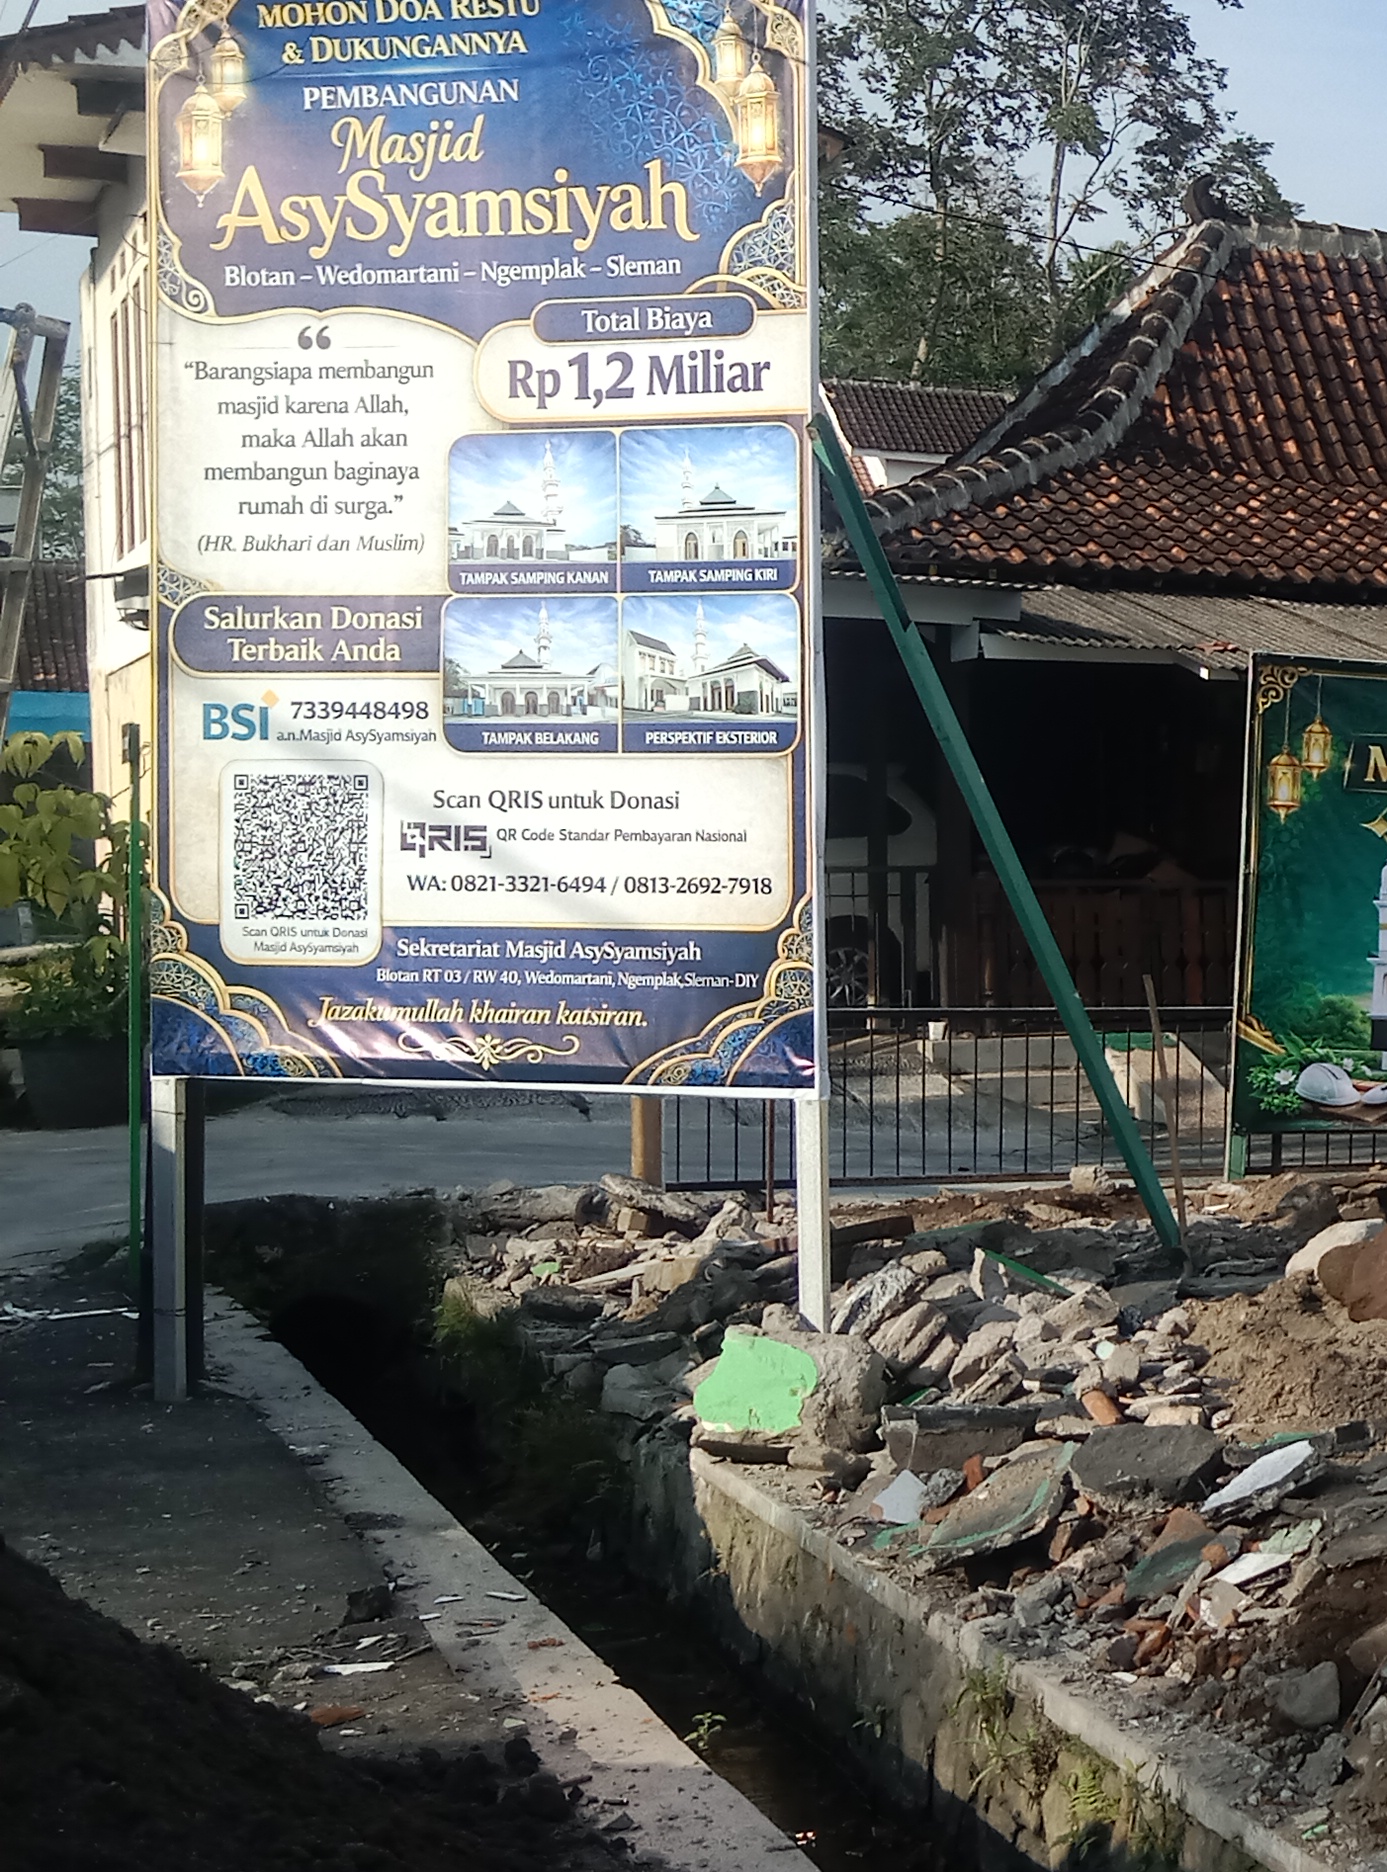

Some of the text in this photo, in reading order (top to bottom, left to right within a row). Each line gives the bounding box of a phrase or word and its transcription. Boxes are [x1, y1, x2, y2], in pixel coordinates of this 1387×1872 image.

[257, 0, 367, 28] MOHON
[376, 0, 444, 24] DOA
[281, 31, 528, 64] & DUKUNGANNYA
[303, 79, 519, 110] PEMBANGUNAN
[331, 114, 484, 181] Masjid
[210, 159, 700, 259] AsySyamsiyah
[224, 265, 296, 287] Blotan
[316, 261, 459, 285] Wedomartani
[481, 257, 585, 288] Ngemplak
[607, 255, 681, 277] Sleman
[581, 307, 713, 335] Total Biaya
[184, 359, 434, 386] “Barangsiapa membangun
[507, 349, 771, 409] Rp 1,2 Miliar
[217, 394, 409, 419] masjid karena Allah,
[241, 427, 408, 448] maka Allah akan
[203, 460, 420, 486] membangun baginaya
[238, 494, 403, 520] rumah di surga.”
[197, 533, 425, 555] (HR. Bukhari dan Muslim)
[459, 571, 609, 586] TAMPAK SAMPING KANAN
[648, 568, 777, 583] TAMPAK SAMPING KIRI
[203, 605, 423, 630] Salurkan Donasi
[227, 637, 401, 662] Terbaik Anda
[290, 701, 429, 720] 7339448498
[345, 728, 437, 745] AsySyamsiyah
[482, 731, 599, 745] TAMPAK BELAKANG
[645, 731, 778, 745] PERSPEKTIF EKSTERIOR
[433, 790, 680, 812] Scan QRIS untuk Donasi
[400, 820, 492, 858] QRIS
[497, 828, 747, 844] QR Code Standar Pembayaran Nasional
[406, 874, 773, 894] WA: 0821-3321-6494 / 0813-2692-7918
[242, 926, 368, 938] Scan QRIS untuk Donasi
[254, 941, 359, 955] Masjid AsySyamsiyah
[396, 938, 702, 966] Sekretariat Masjid AsySyamsiyah
[376, 968, 419, 982] Blotan
[422, 969, 442, 982] RT
[444, 970, 462, 983] 03
[472, 970, 497, 983] RW
[500, 970, 522, 986] 40,
[524, 971, 616, 988] Wedomartani,
[307, 996, 648, 1027] Jazakumullah khairan katsiran.
